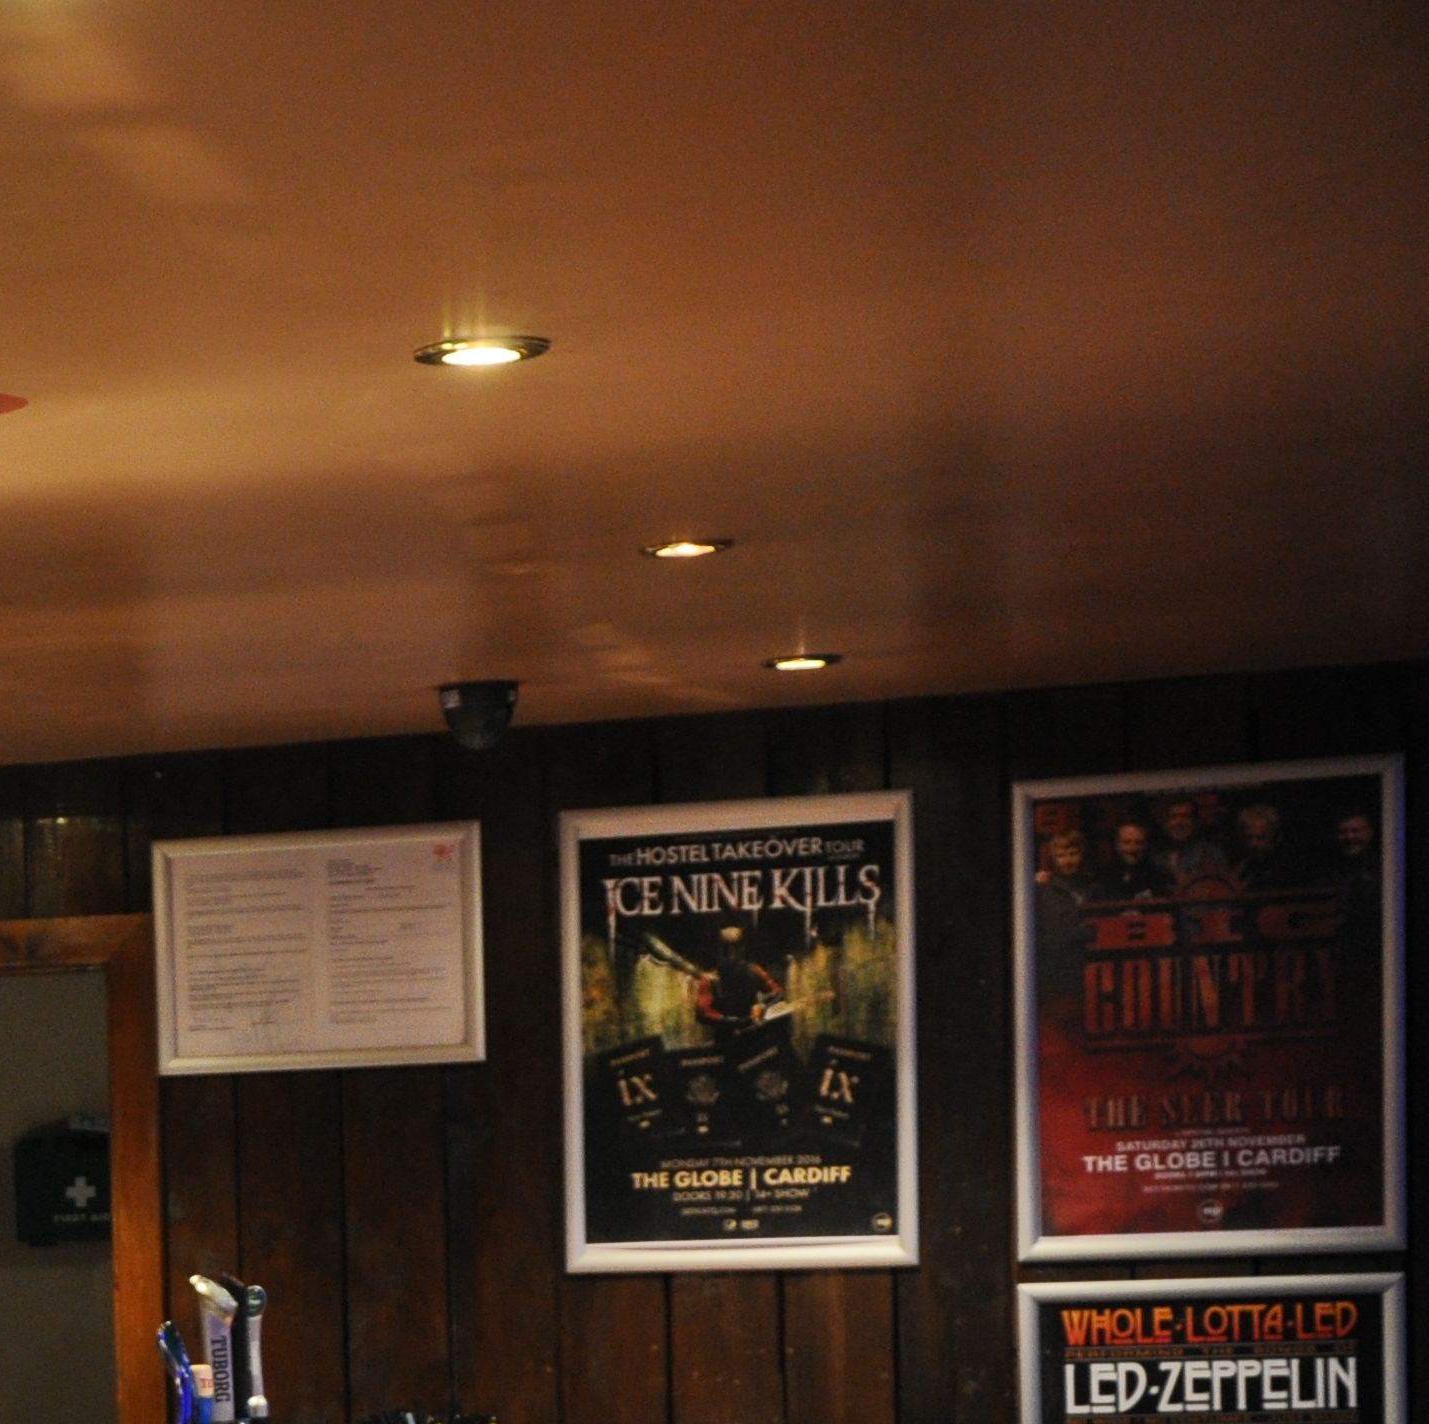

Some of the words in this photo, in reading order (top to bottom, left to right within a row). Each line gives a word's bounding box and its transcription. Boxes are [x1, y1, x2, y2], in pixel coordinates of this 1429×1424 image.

[636, 843, 709, 867] HOSTEL
[710, 836, 822, 861] TAKEOVER
[601, 876, 663, 930] ICE
[670, 869, 764, 915] NINE
[768, 863, 882, 918] KILLS
[1082, 1153, 1129, 1173] THE
[1133, 1149, 1217, 1171] GLOBE
[1236, 1145, 1341, 1168] CARDIFF
[630, 1171, 670, 1190] THE
[673, 1168, 744, 1188] GLOBE
[762, 1164, 852, 1186] CARDIFF
[210, 1334, 232, 1403] TUBORG
